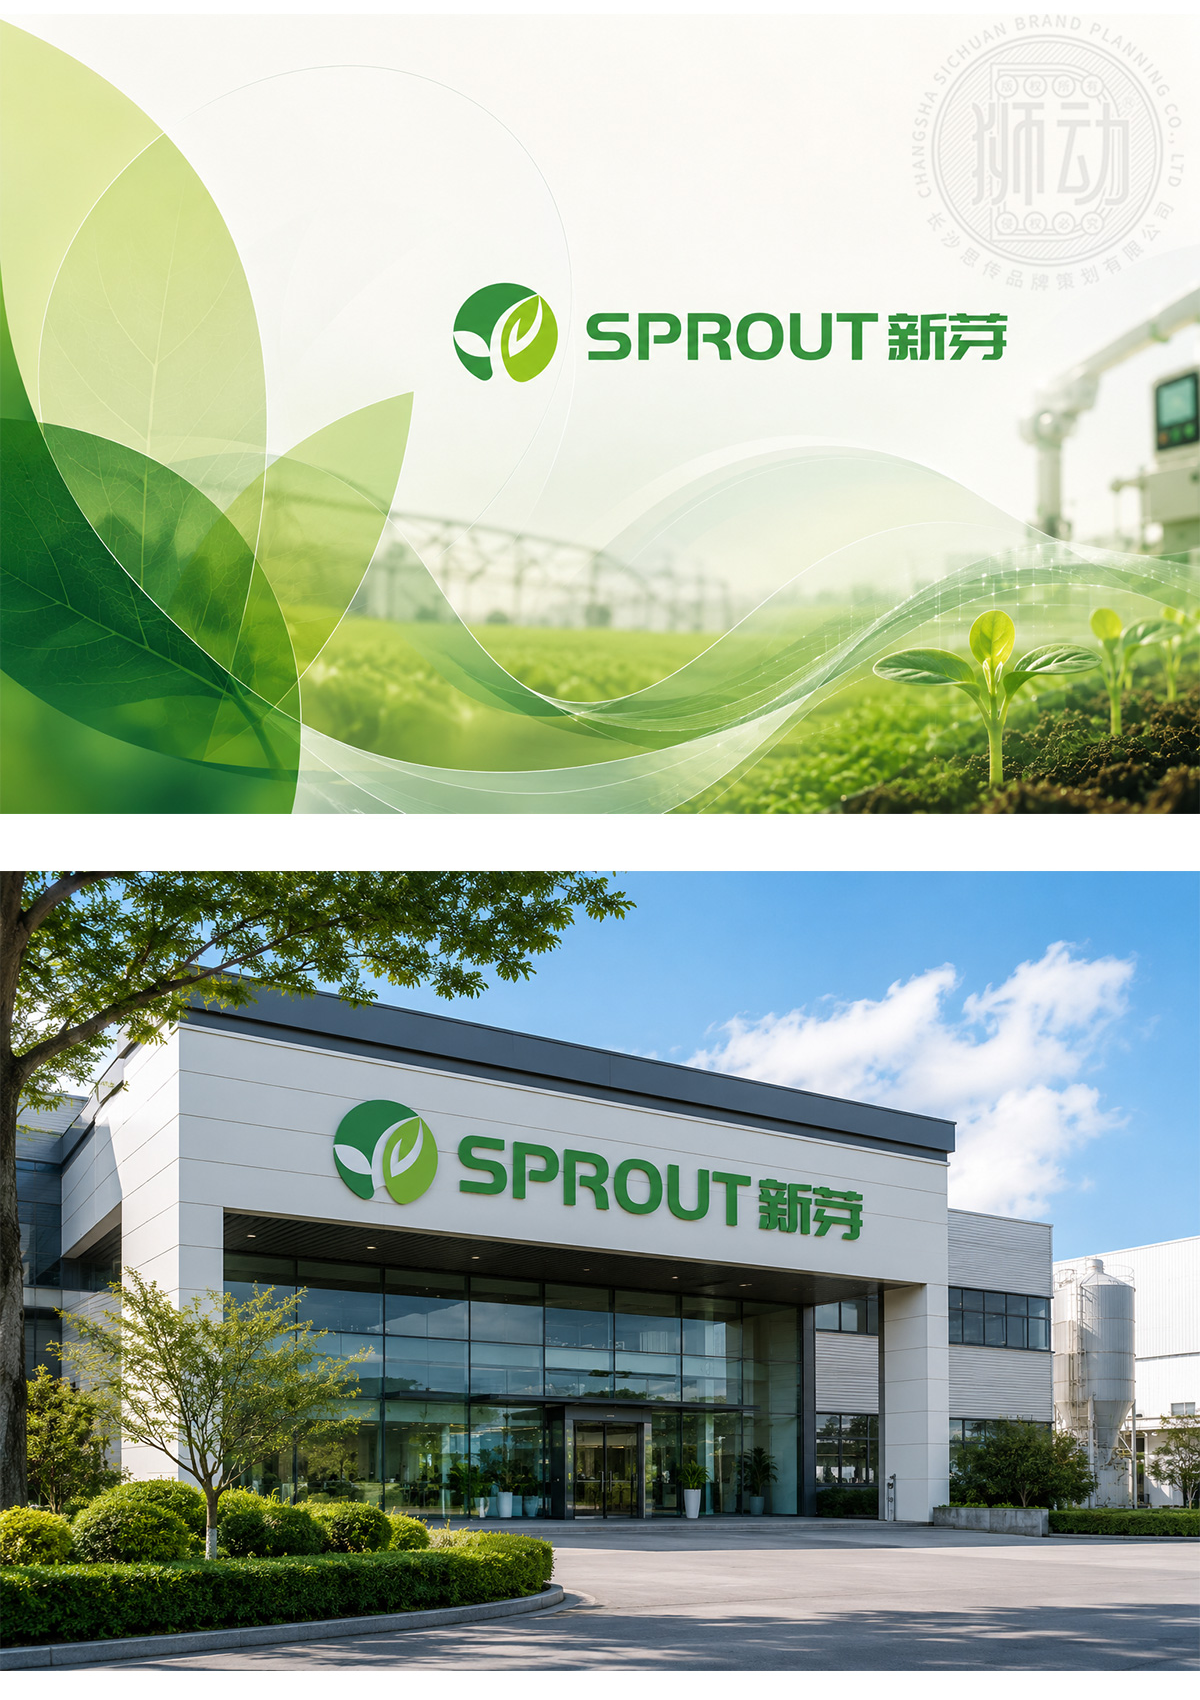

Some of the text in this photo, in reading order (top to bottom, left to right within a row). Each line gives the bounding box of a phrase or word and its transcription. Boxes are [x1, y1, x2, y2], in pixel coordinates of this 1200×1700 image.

[586, 312, 1008, 361] SPROUT 新芽
[458, 1134, 864, 1241] SPROUT 新芽
